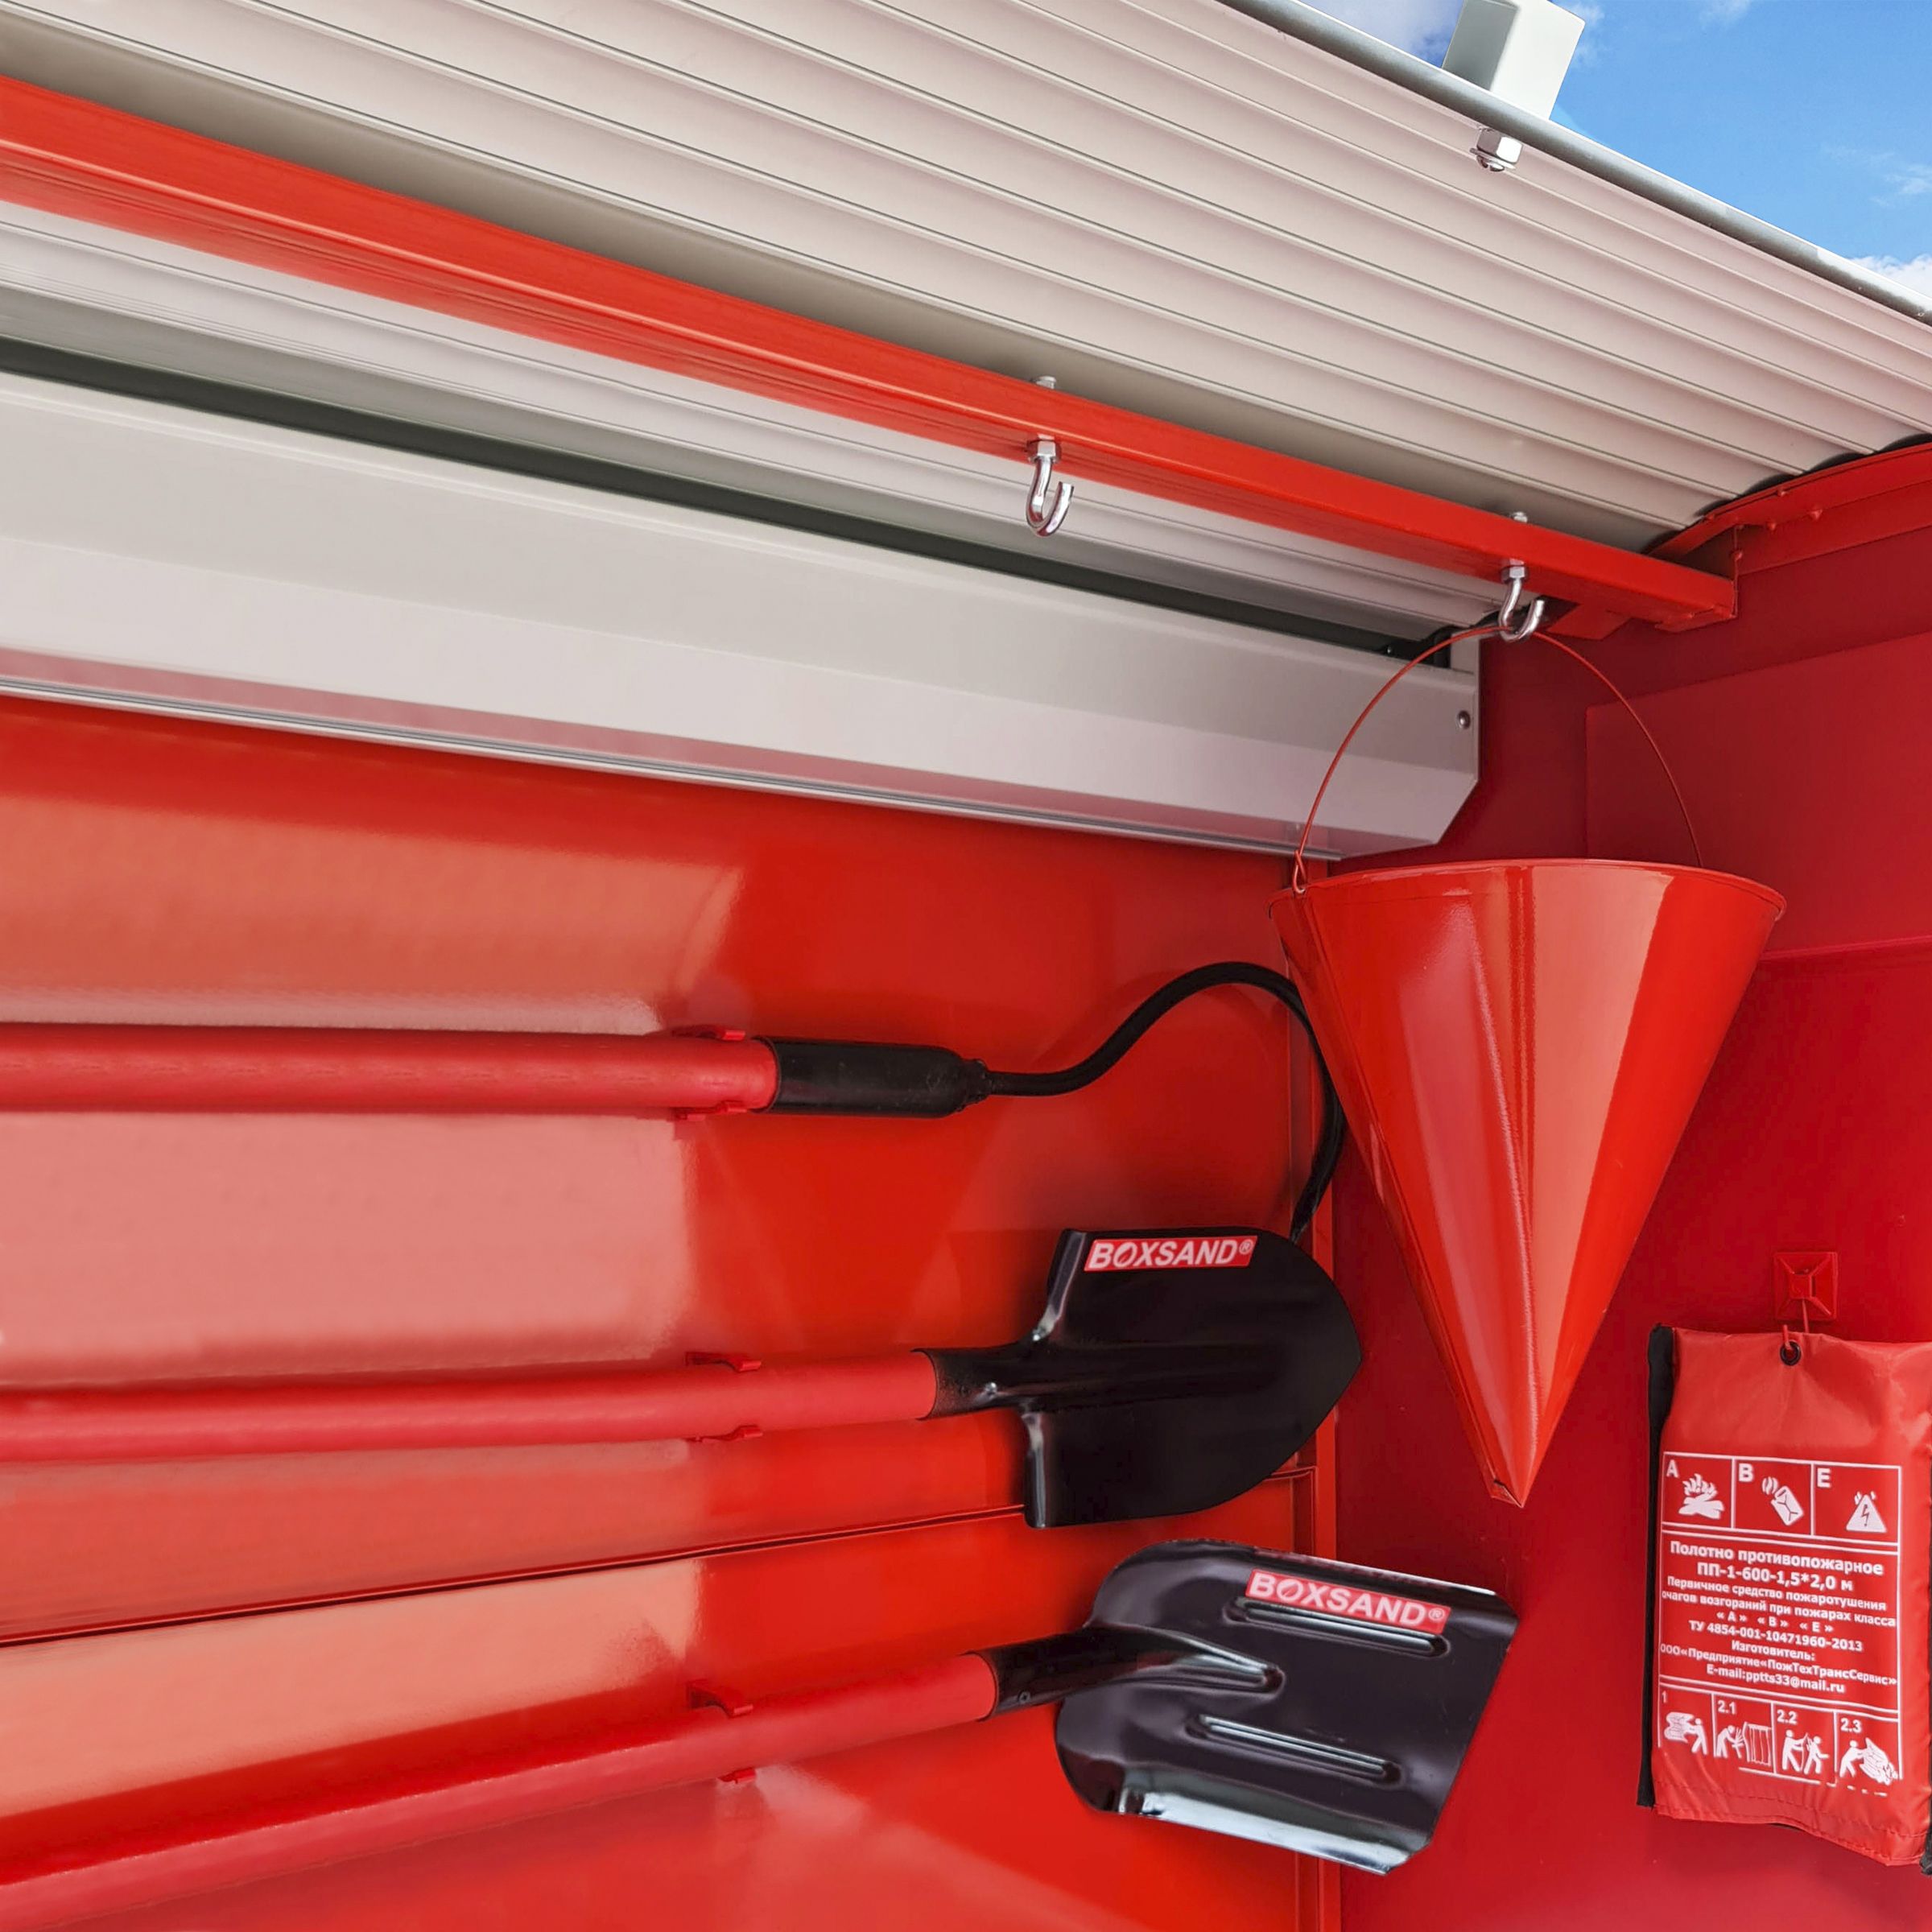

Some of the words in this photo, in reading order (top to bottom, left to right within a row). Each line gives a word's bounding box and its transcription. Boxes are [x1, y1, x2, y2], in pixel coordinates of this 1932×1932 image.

[1670, 1540, 1734, 1559] Полотно
[1738, 1550, 1884, 1575] противопожарное
[1662, 1590, 1698, 1604] очагов
[1699, 1595, 1767, 1611] возгораний
[1769, 1604, 1791, 1616] при
[1794, 1606, 1852, 1621] пожарах
[1854, 1613, 1897, 1627] класса
[1667, 1575, 1730, 1593] Первичное
[1732, 1585, 1783, 1599] средство
[1785, 1592, 1887, 1611] пожаротушения
[1688, 1620, 1705, 1632] ТУ
[1707, 1623, 1863, 1651] 4854-001-10471960-2013
[1731, 1640, 1815, 1661] Изготовитель:
[1717, 1699, 1736, 1715] 2.1
[1776, 1709, 1798, 1725] 2.2
[1839, 1717, 1862, 1733] 2.3
